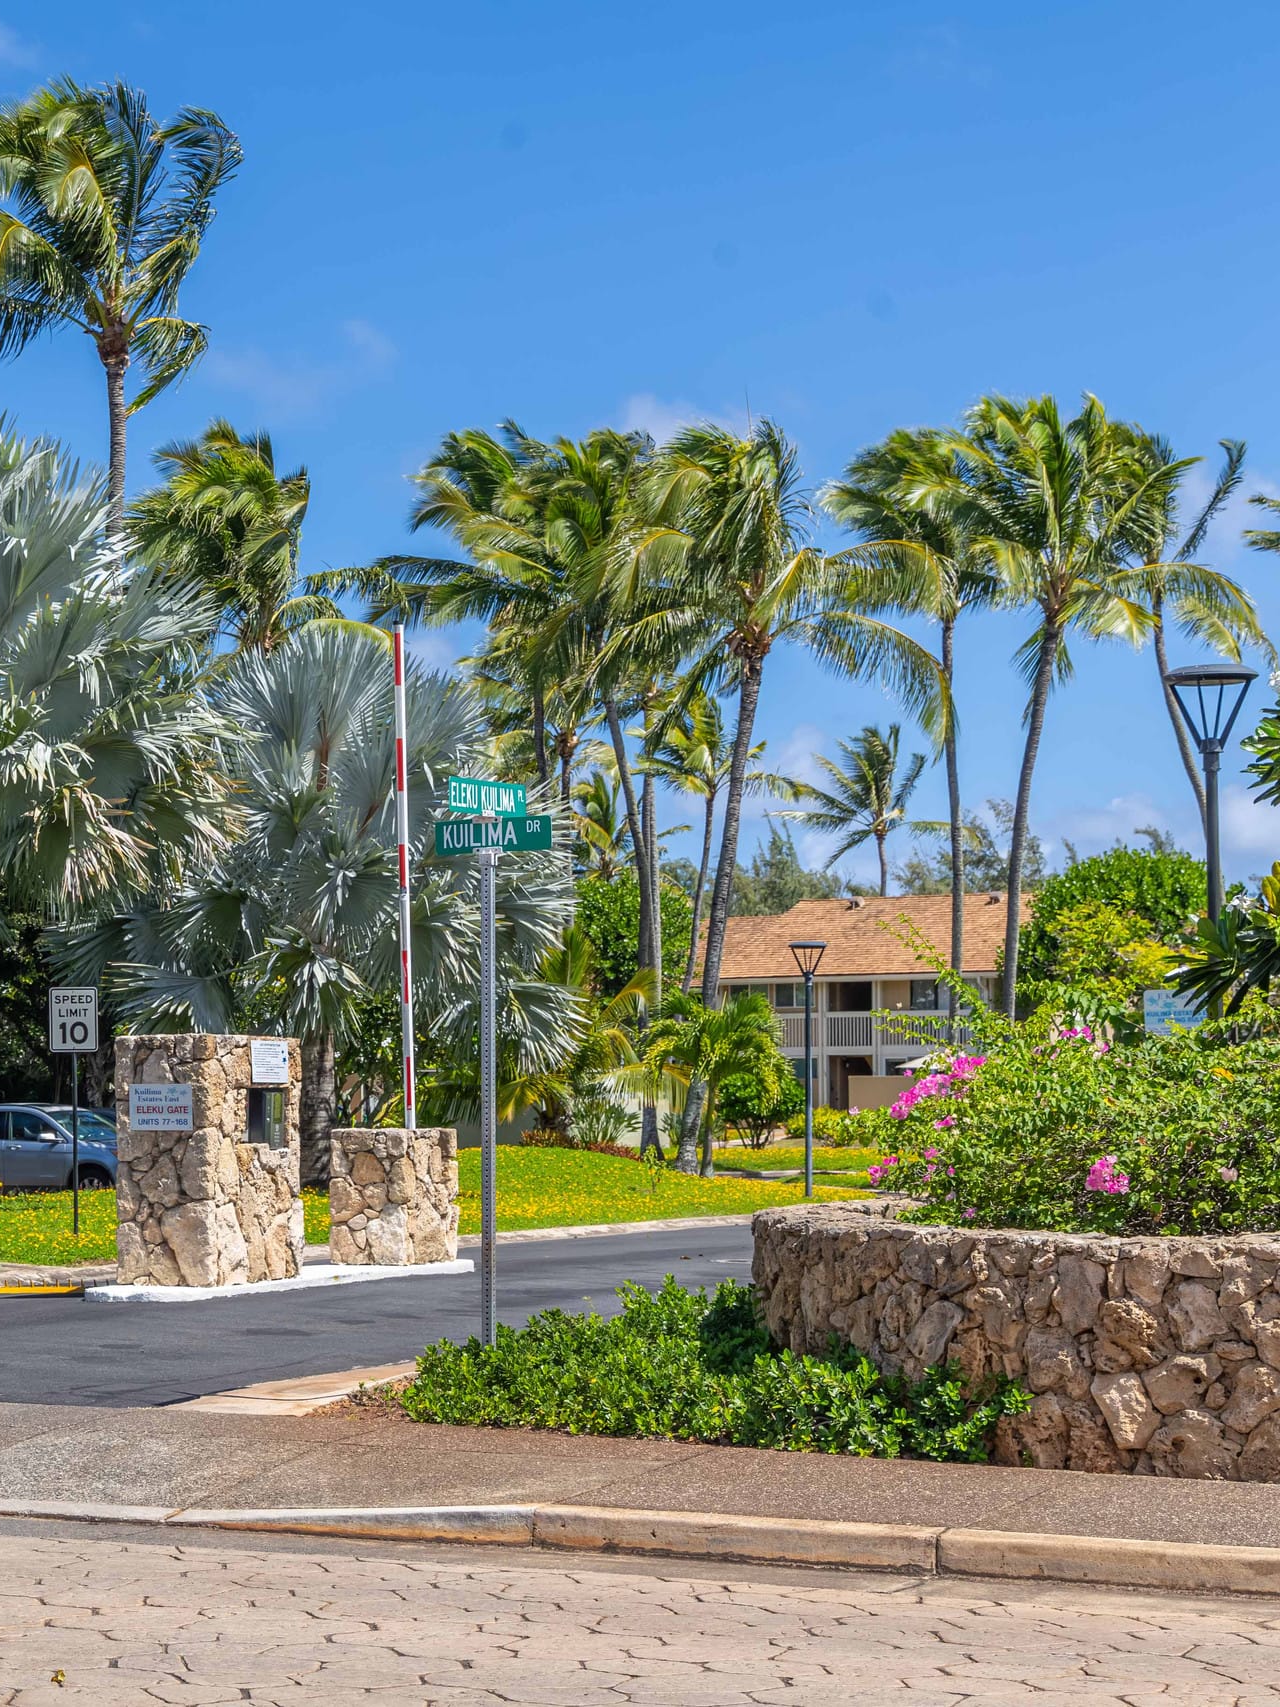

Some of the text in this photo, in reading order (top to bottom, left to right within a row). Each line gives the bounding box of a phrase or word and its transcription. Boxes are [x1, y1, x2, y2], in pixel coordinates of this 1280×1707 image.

[451, 782, 524, 813] ELEKU KUILIMA PL
[443, 820, 541, 849] KUILIMA DR
[54, 995, 93, 1004] SPEED
[58, 1008, 89, 1018] LIMIT
[58, 1021, 89, 1044] 10
[136, 1105, 189, 1114] ELEKU GATE
[137, 1118, 189, 1126] UNITS 77-168
